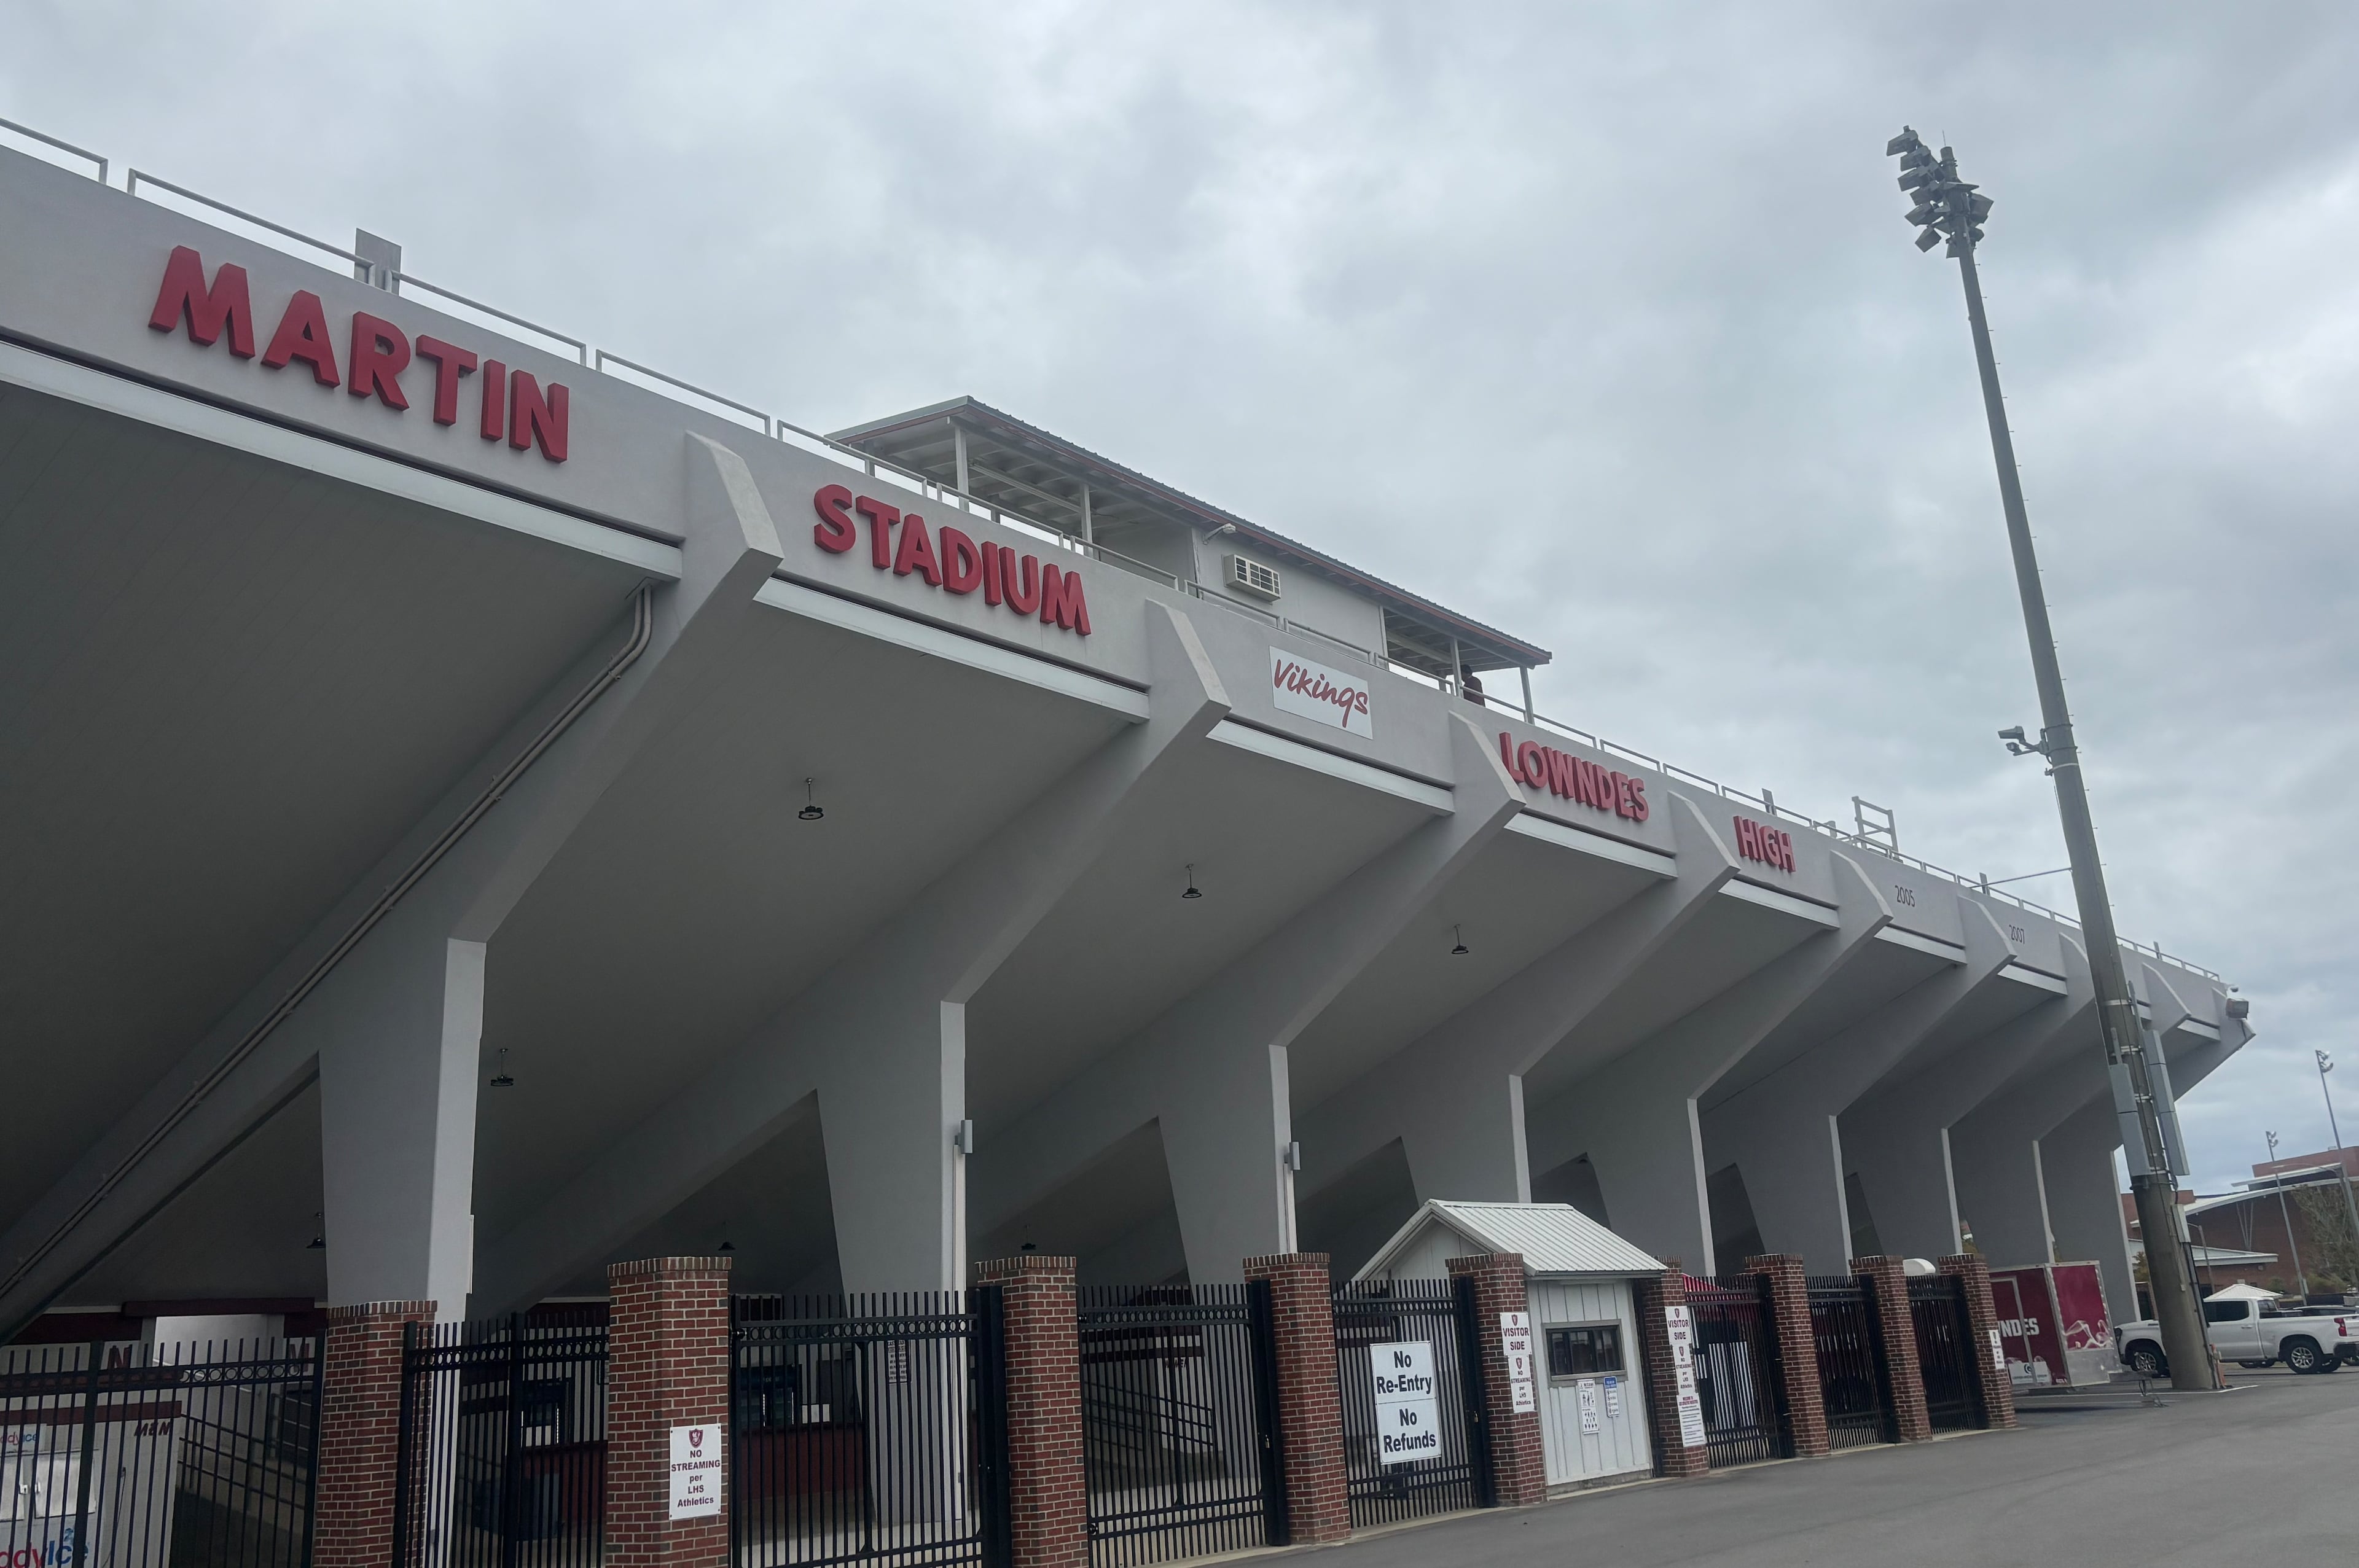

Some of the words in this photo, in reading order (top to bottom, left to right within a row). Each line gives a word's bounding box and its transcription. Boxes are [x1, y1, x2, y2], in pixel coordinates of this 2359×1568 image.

[148, 245, 569, 462] MARTIN
[814, 484, 1091, 636] STADIUM
[1274, 659, 1368, 728] Vikings
[1499, 731, 1649, 822] LOWNDES
[1733, 816, 1796, 872] HIGH
[1895, 885, 1915, 907] 2005
[2009, 924, 2025, 944] 2007
[1503, 1327, 1529, 1337] VISITOR
[1667, 1319, 1689, 1328] VISITOR
[1998, 1317, 2040, 1337] NDES
[1674, 1332, 1686, 1340] SIDE
[1510, 1341, 1525, 1351] SIDE
[1394, 1351, 1412, 1368] No
[1376, 1374, 1431, 1394] Re-Entry
[1399, 1408, 1417, 1426] No
[1383, 1430, 1436, 1453] Refunds
[690, 1449, 702, 1458] NO
[671, 1459, 721, 1472] STREAMING
[689, 1475, 703, 1484] per
[688, 1484, 704, 1494] LHS
[677, 1496, 714, 1508] Athletics
